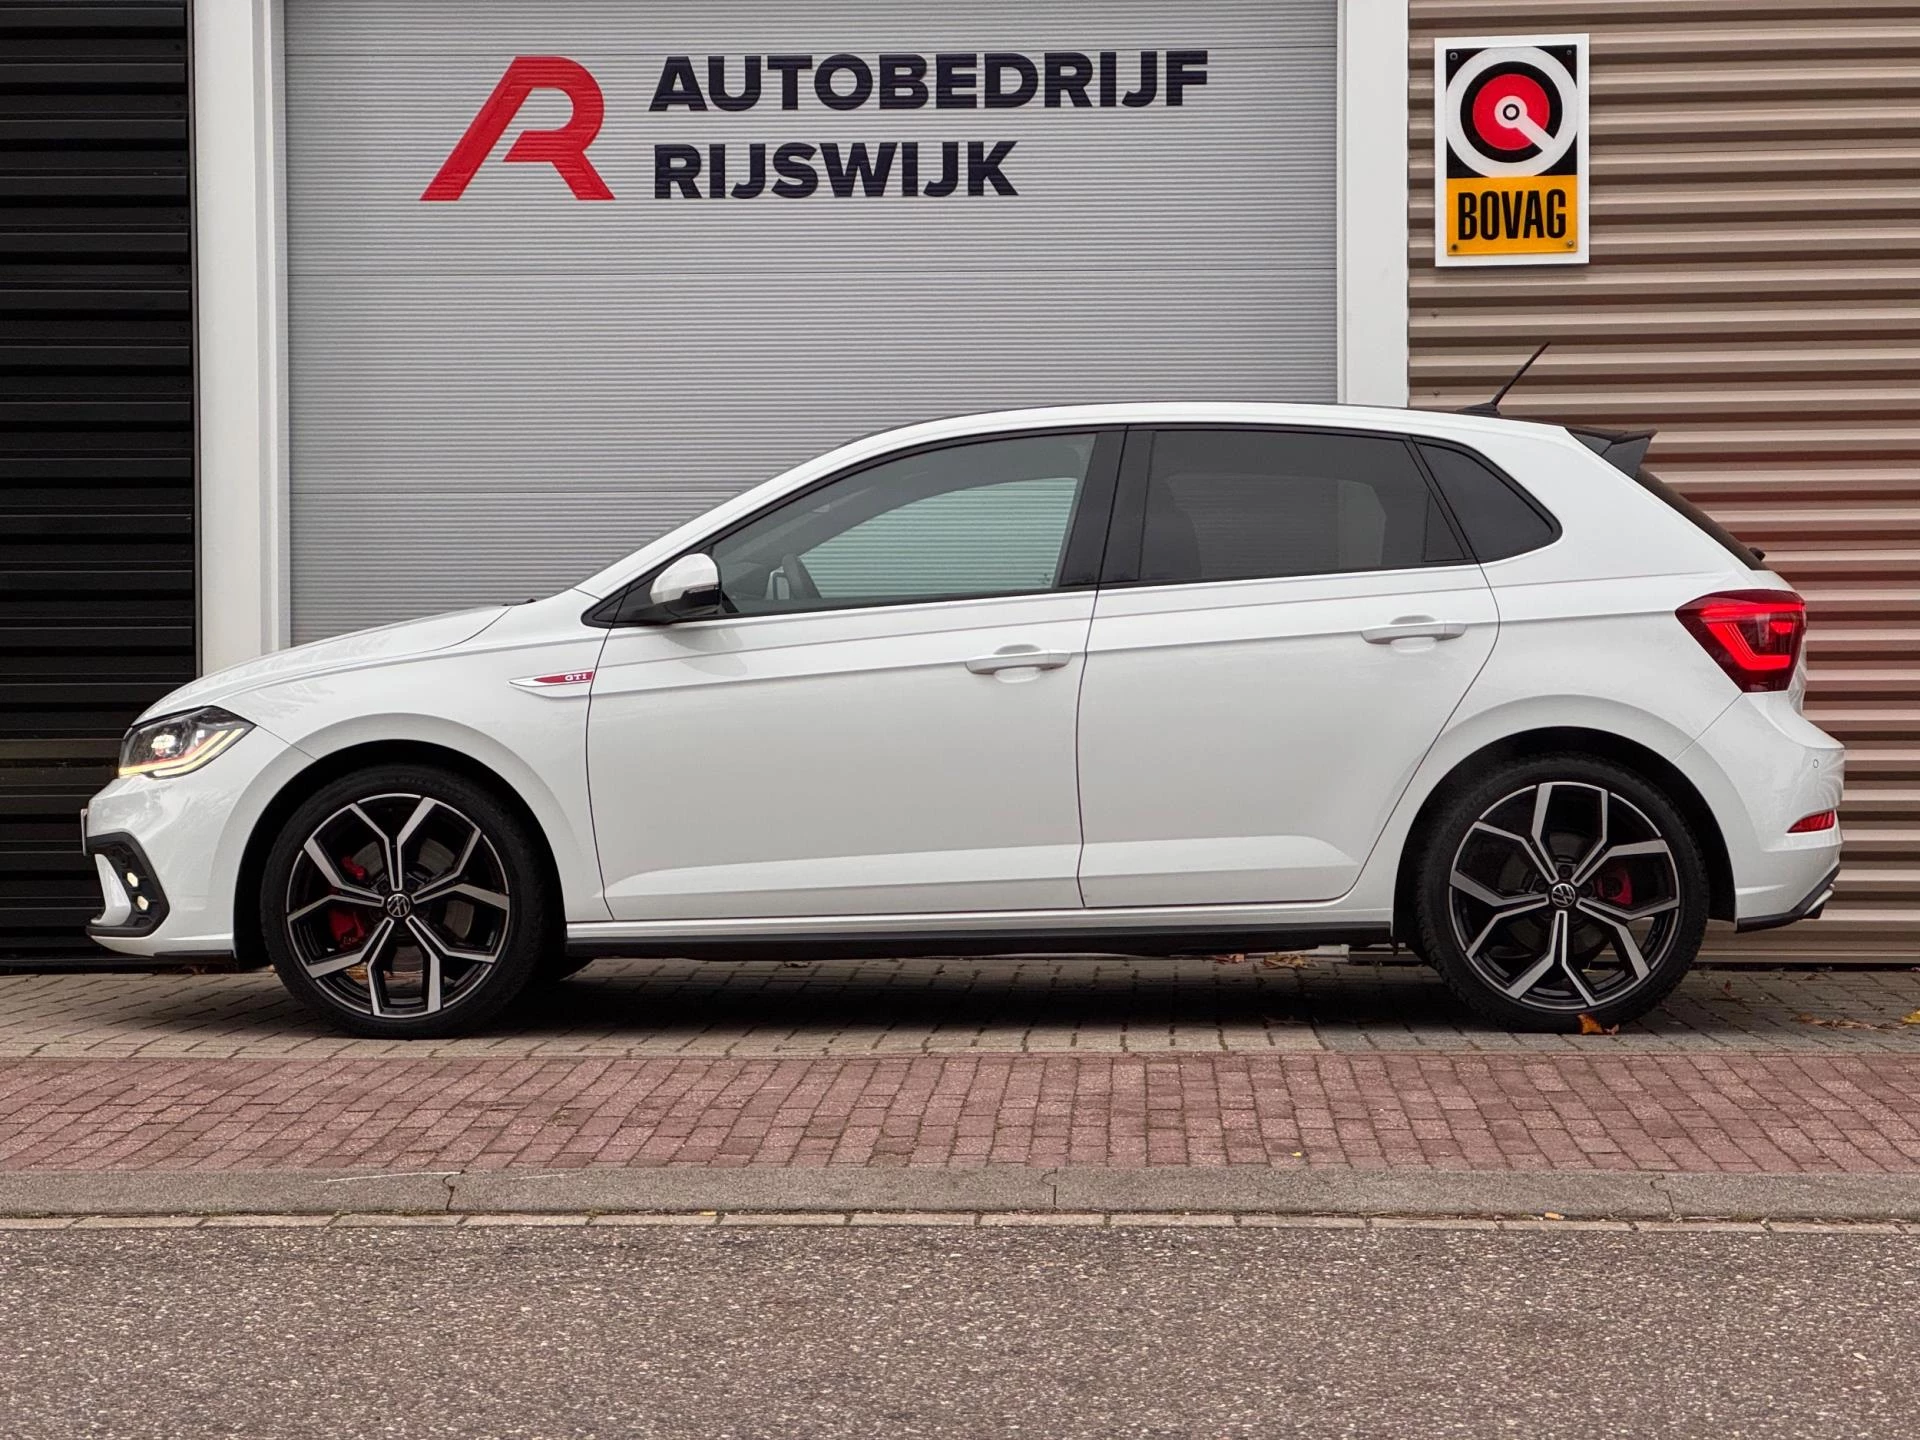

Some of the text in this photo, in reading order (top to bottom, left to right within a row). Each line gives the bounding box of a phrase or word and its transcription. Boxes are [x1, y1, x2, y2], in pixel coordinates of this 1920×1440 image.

[648, 50, 1208, 112] AUTOBEDRIJF
[654, 140, 1019, 199] RIJSWIJK
[1457, 189, 1567, 241] BOVAG
[564, 673, 587, 681] GTI
